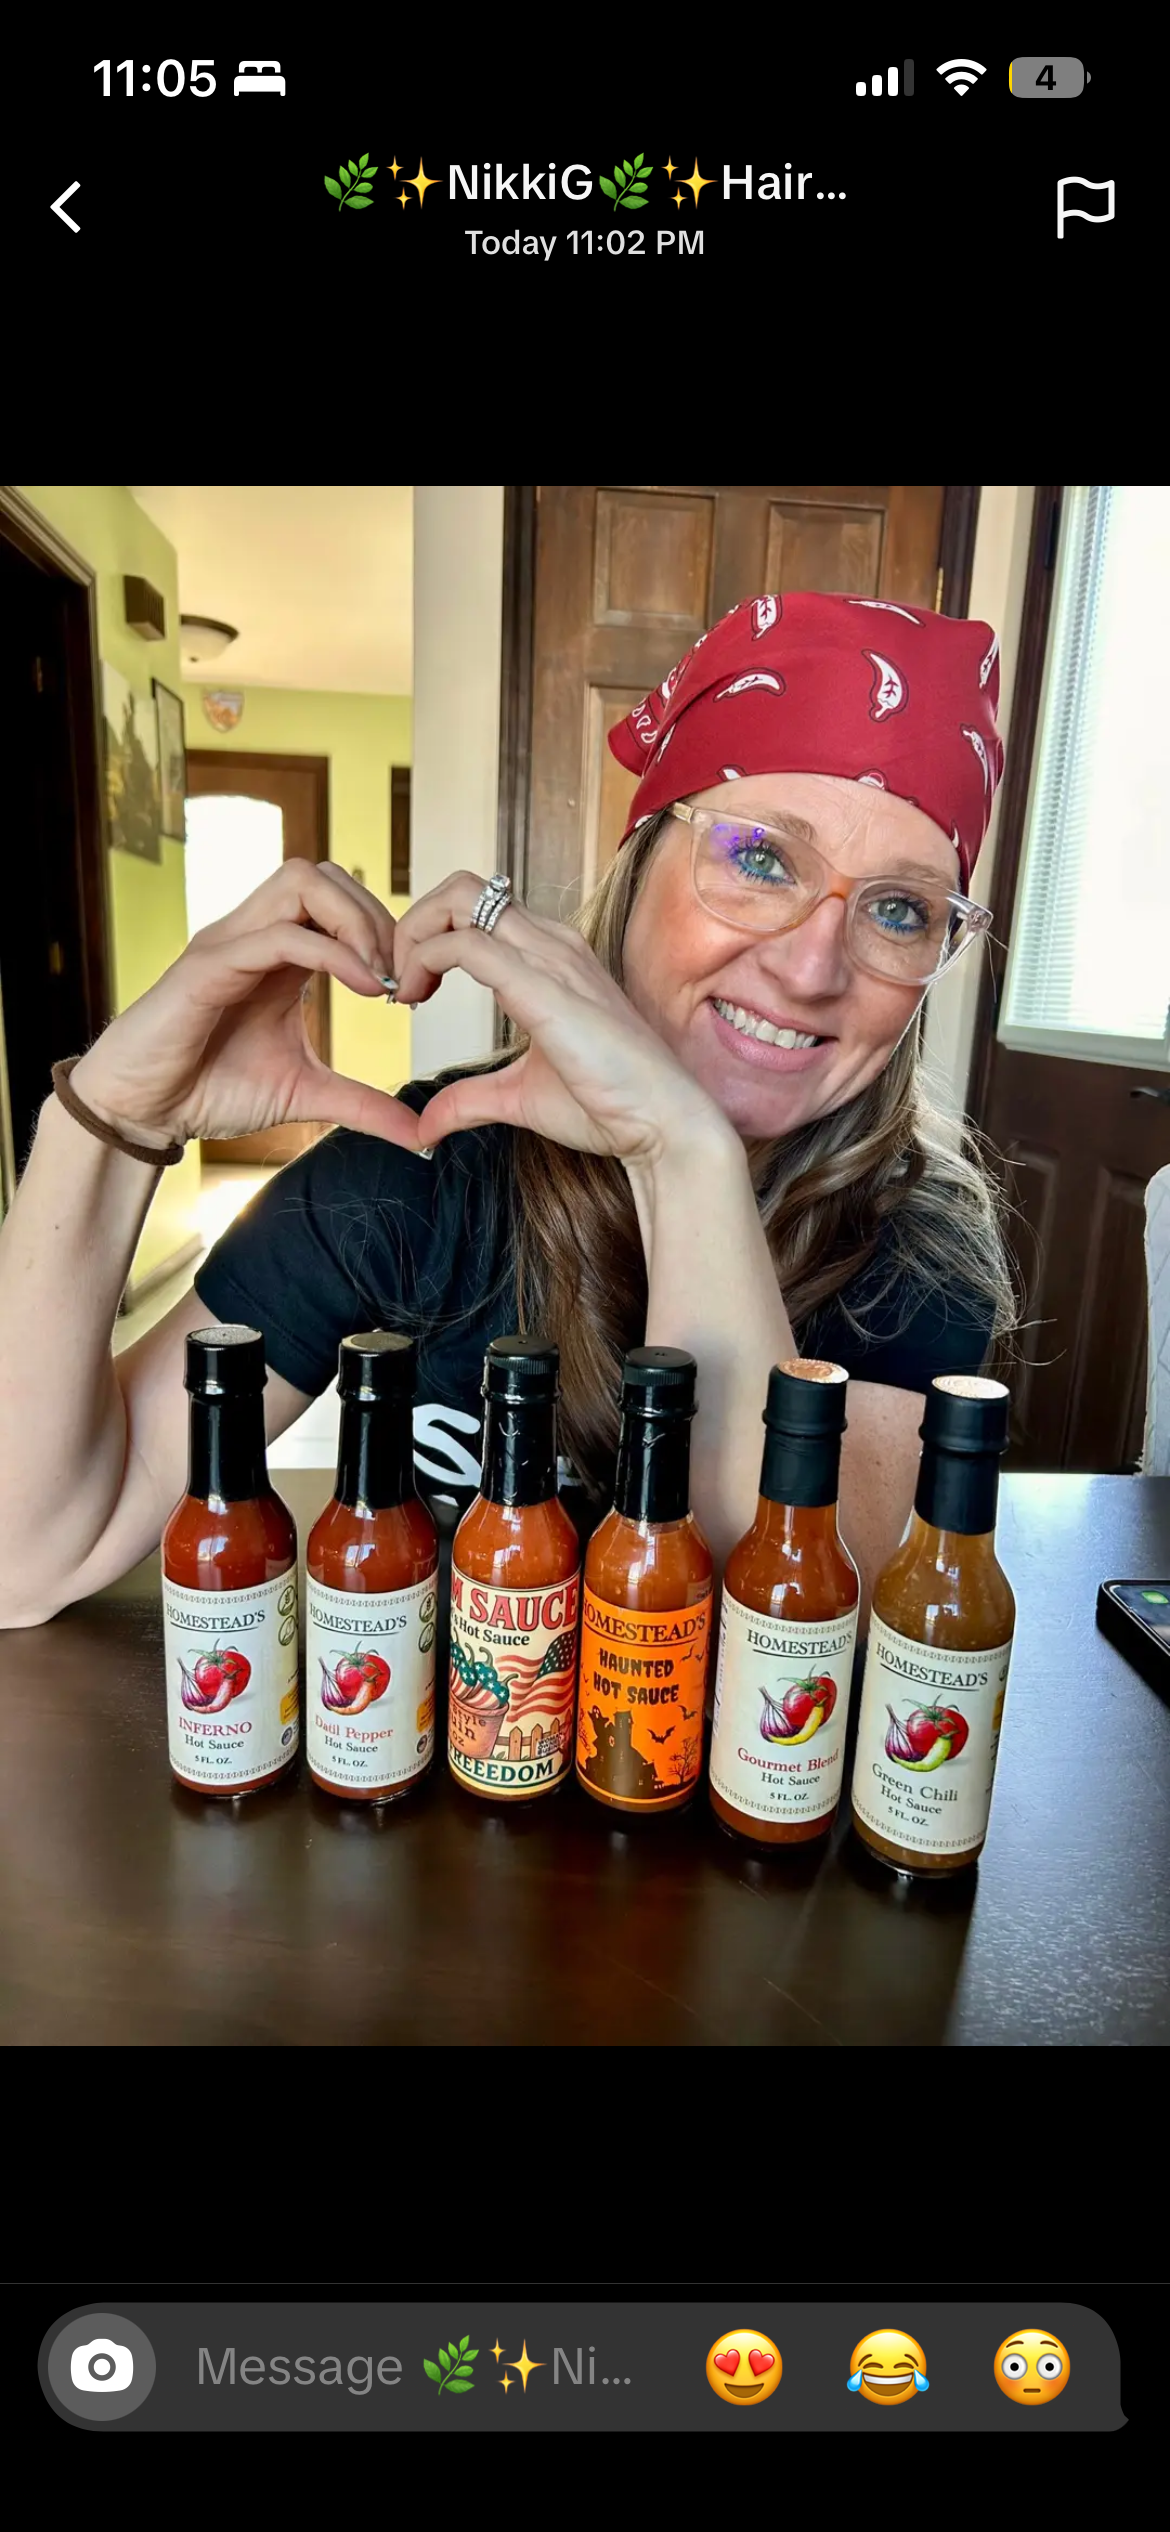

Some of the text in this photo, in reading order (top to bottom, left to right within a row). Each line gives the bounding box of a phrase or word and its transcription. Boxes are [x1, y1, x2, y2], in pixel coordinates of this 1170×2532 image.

[166, 1603, 266, 1630] HOMESTEAD'S
[310, 1603, 407, 1633] HOMESTEAD'S
[469, 1578, 578, 1631] SAUCE
[459, 1616, 480, 1639] Hot
[482, 1629, 530, 1646] Sauce
[599, 1647, 674, 1678] HAUNTED
[876, 1642, 988, 1686] HOMESTEAD'S
[593, 1671, 679, 1705] HOT SAUCE
[179, 1716, 252, 1736] INFERNO
[315, 1714, 340, 1736] Datil
[345, 1726, 394, 1743] Pepper
[185, 1734, 244, 1750] Hot Sauce
[324, 1735, 378, 1753] Hot Sauce
[737, 1747, 840, 1773] Gourmet Blend
[761, 1772, 820, 1786] Hot Sauce
[872, 1762, 959, 1802] Green Chili
[770, 1792, 775, 1800] 5
[880, 1784, 943, 1815] Hot Sauce
[888, 1805, 894, 1814] 5
